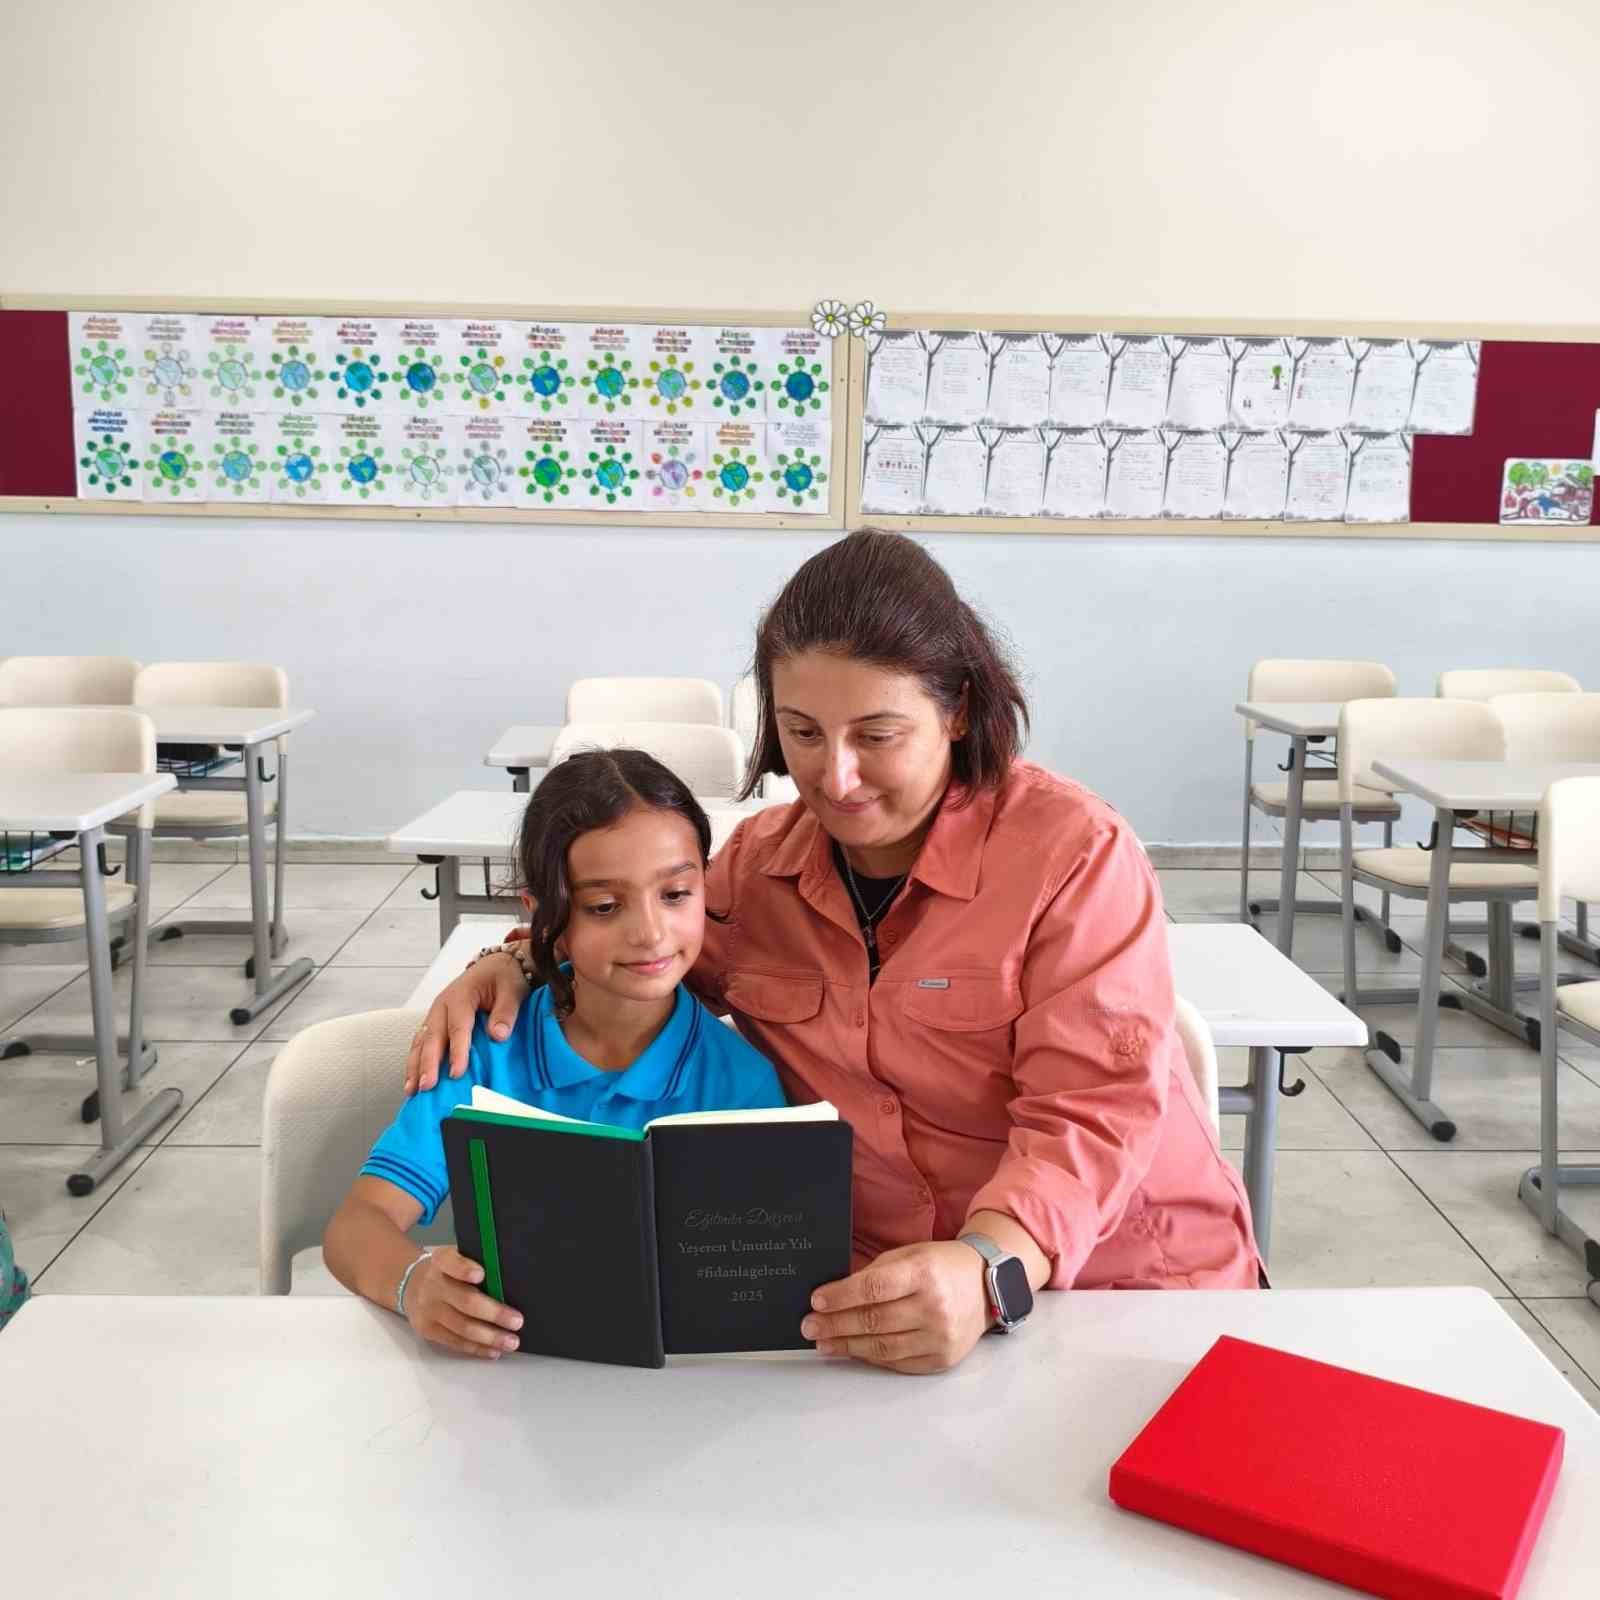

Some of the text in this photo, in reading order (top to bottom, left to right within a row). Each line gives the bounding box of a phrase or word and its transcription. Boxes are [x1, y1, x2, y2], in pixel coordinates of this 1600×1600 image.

[678, 1235, 812, 1255] Yeşeren Umutlar Yılı
[696, 1263, 796, 1280] #fidanlagelecek
[731, 1288, 763, 1302] 2025
